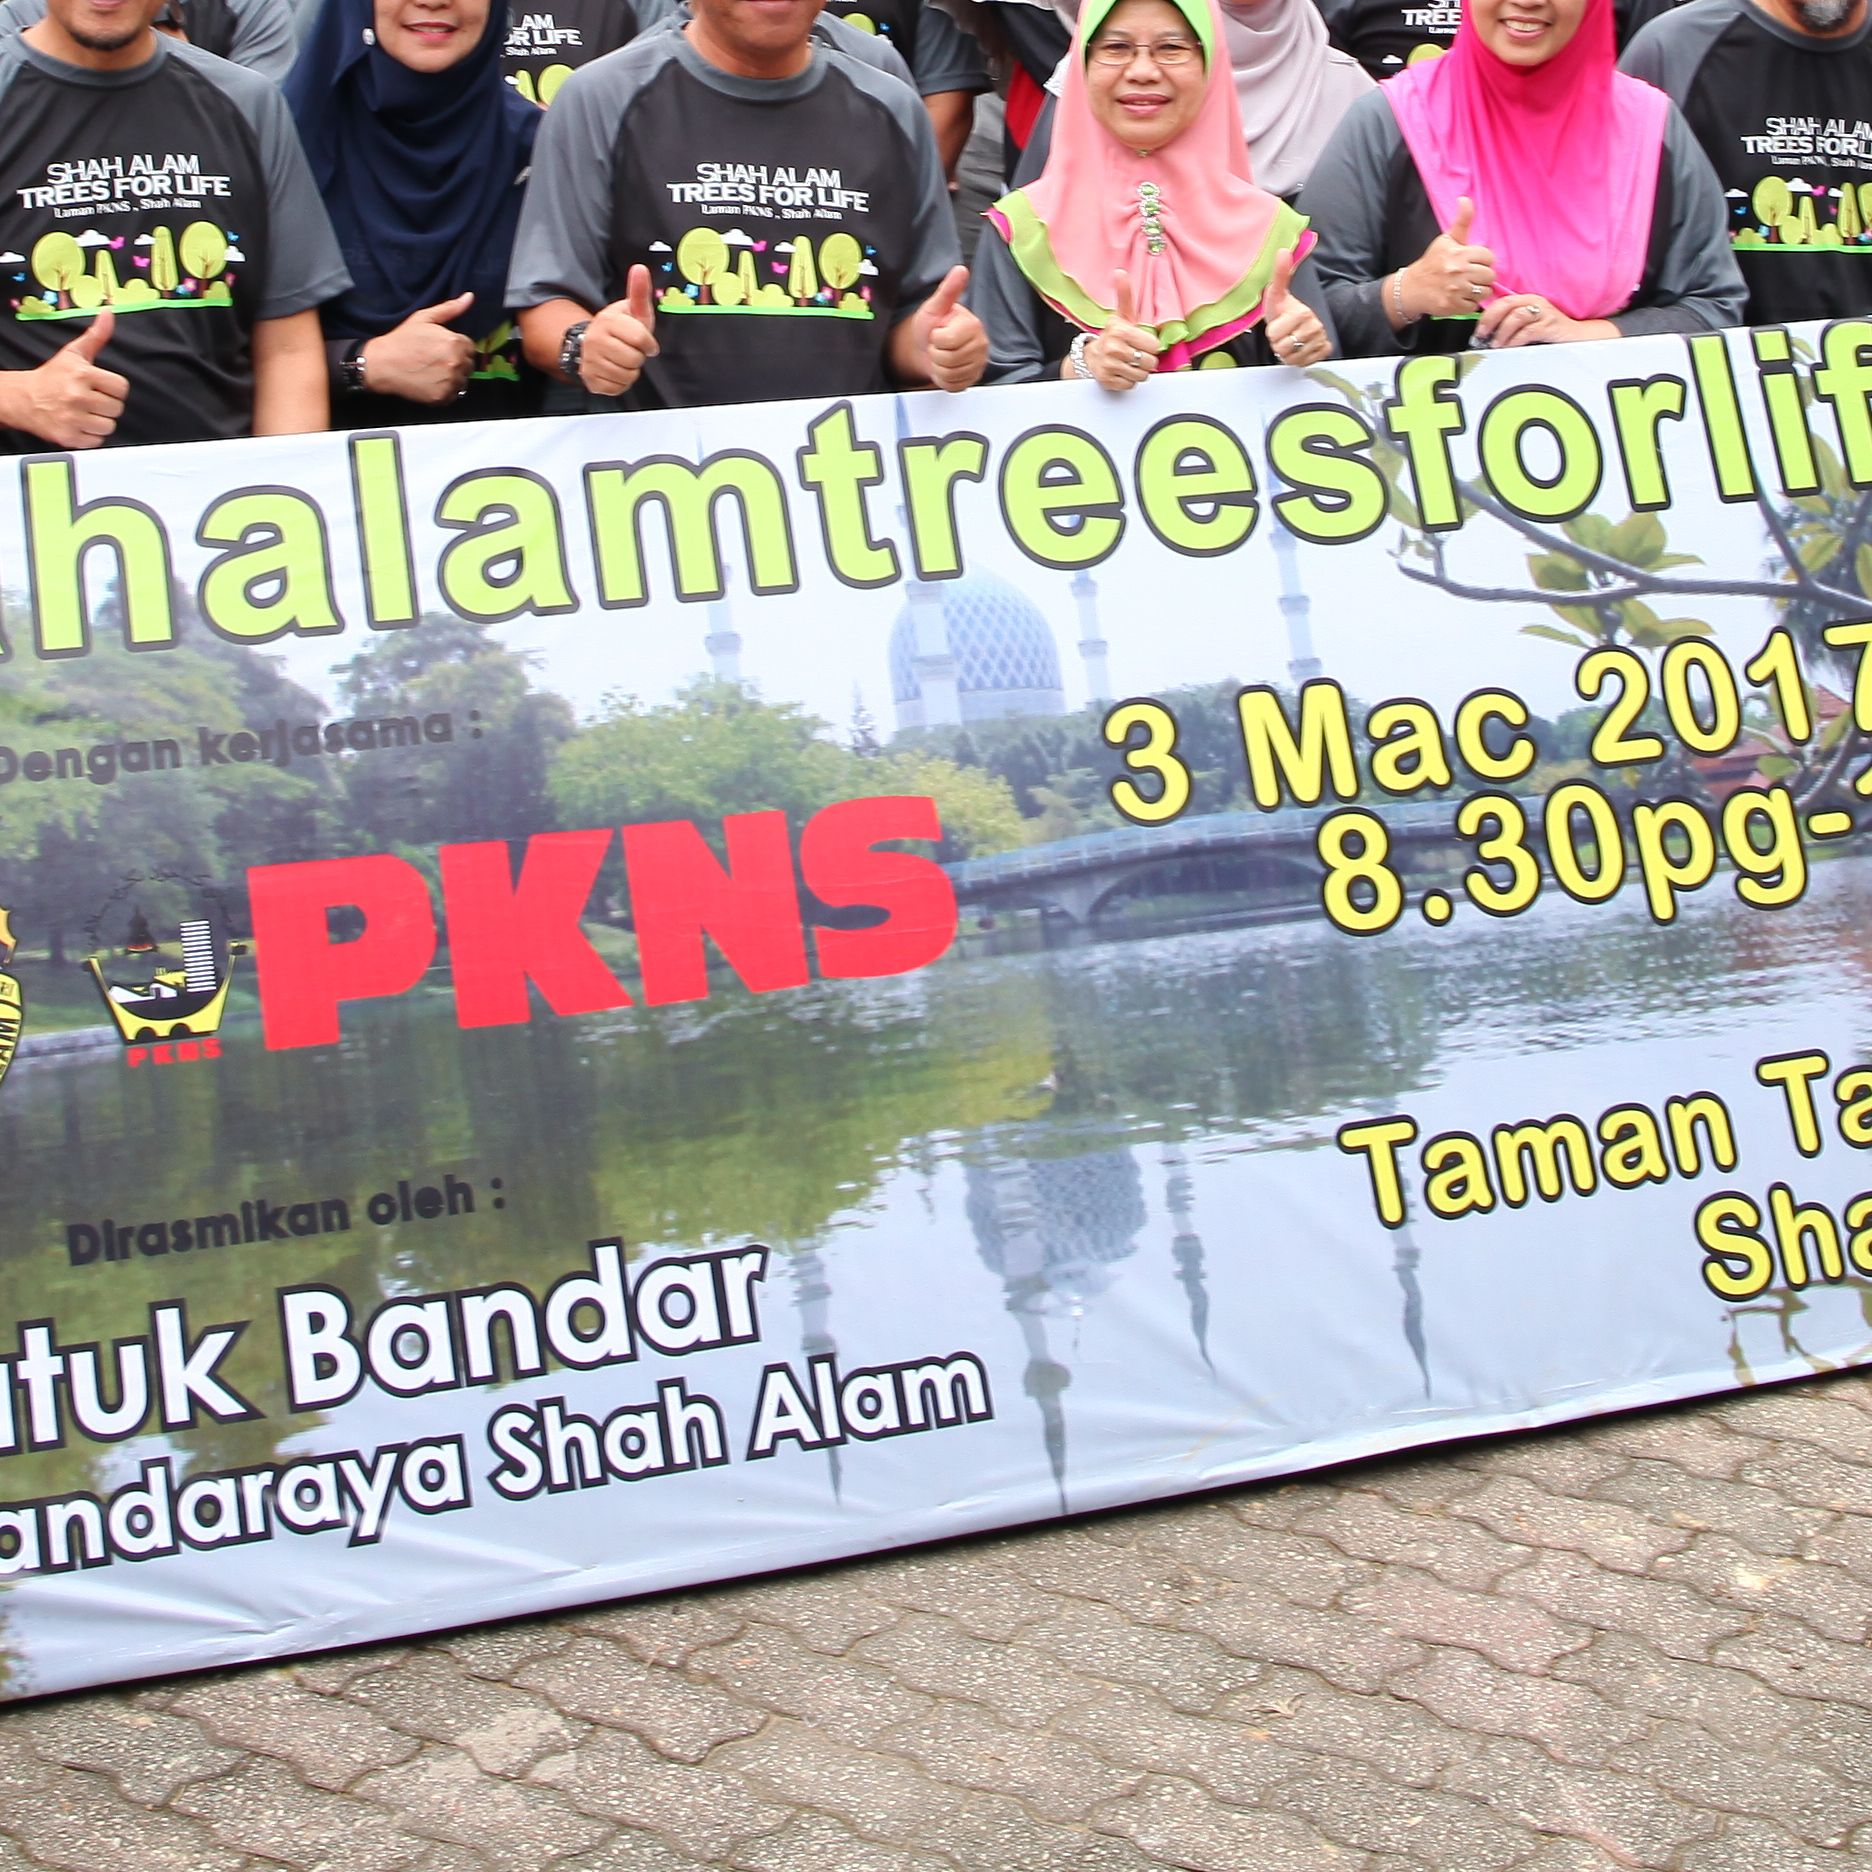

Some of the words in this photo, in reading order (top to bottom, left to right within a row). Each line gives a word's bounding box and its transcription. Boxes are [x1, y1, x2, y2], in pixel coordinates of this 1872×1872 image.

[1400, 8, 1463, 26] TREE
[531, 28, 583, 46] LIFE
[1740, 135, 1815, 155] TREES
[1815, 137, 1860, 157] FOR
[46, 155, 124, 186] SHAH
[128, 152, 200, 176] ALAM
[695, 162, 769, 186] SHAH
[771, 166, 842, 190] ALAM
[16, 180, 111, 209] TREES
[113, 175, 173, 199] FOR
[175, 174, 232, 197] LIFE
[139, 197, 171, 211] Shah
[666, 181, 757, 204] TREES
[758, 183, 815, 207] FOR
[817, 187, 870, 213] LIFE
[781, 207, 812, 220] Shah
[196, 710, 453, 768] kerjasama
[1104, 698, 1191, 825] 3
[1237, 678, 1535, 810] Mac
[246, 794, 960, 1052] PKNS
[1339, 1089, 1737, 1230] Taman
[66, 1196, 351, 1266] Dirasmikan
[367, 1173, 475, 1226] oleh
[280, 1239, 769, 1410] Bandar
[489, 1379, 729, 1499] Shah
[747, 1352, 992, 1460] Alam
